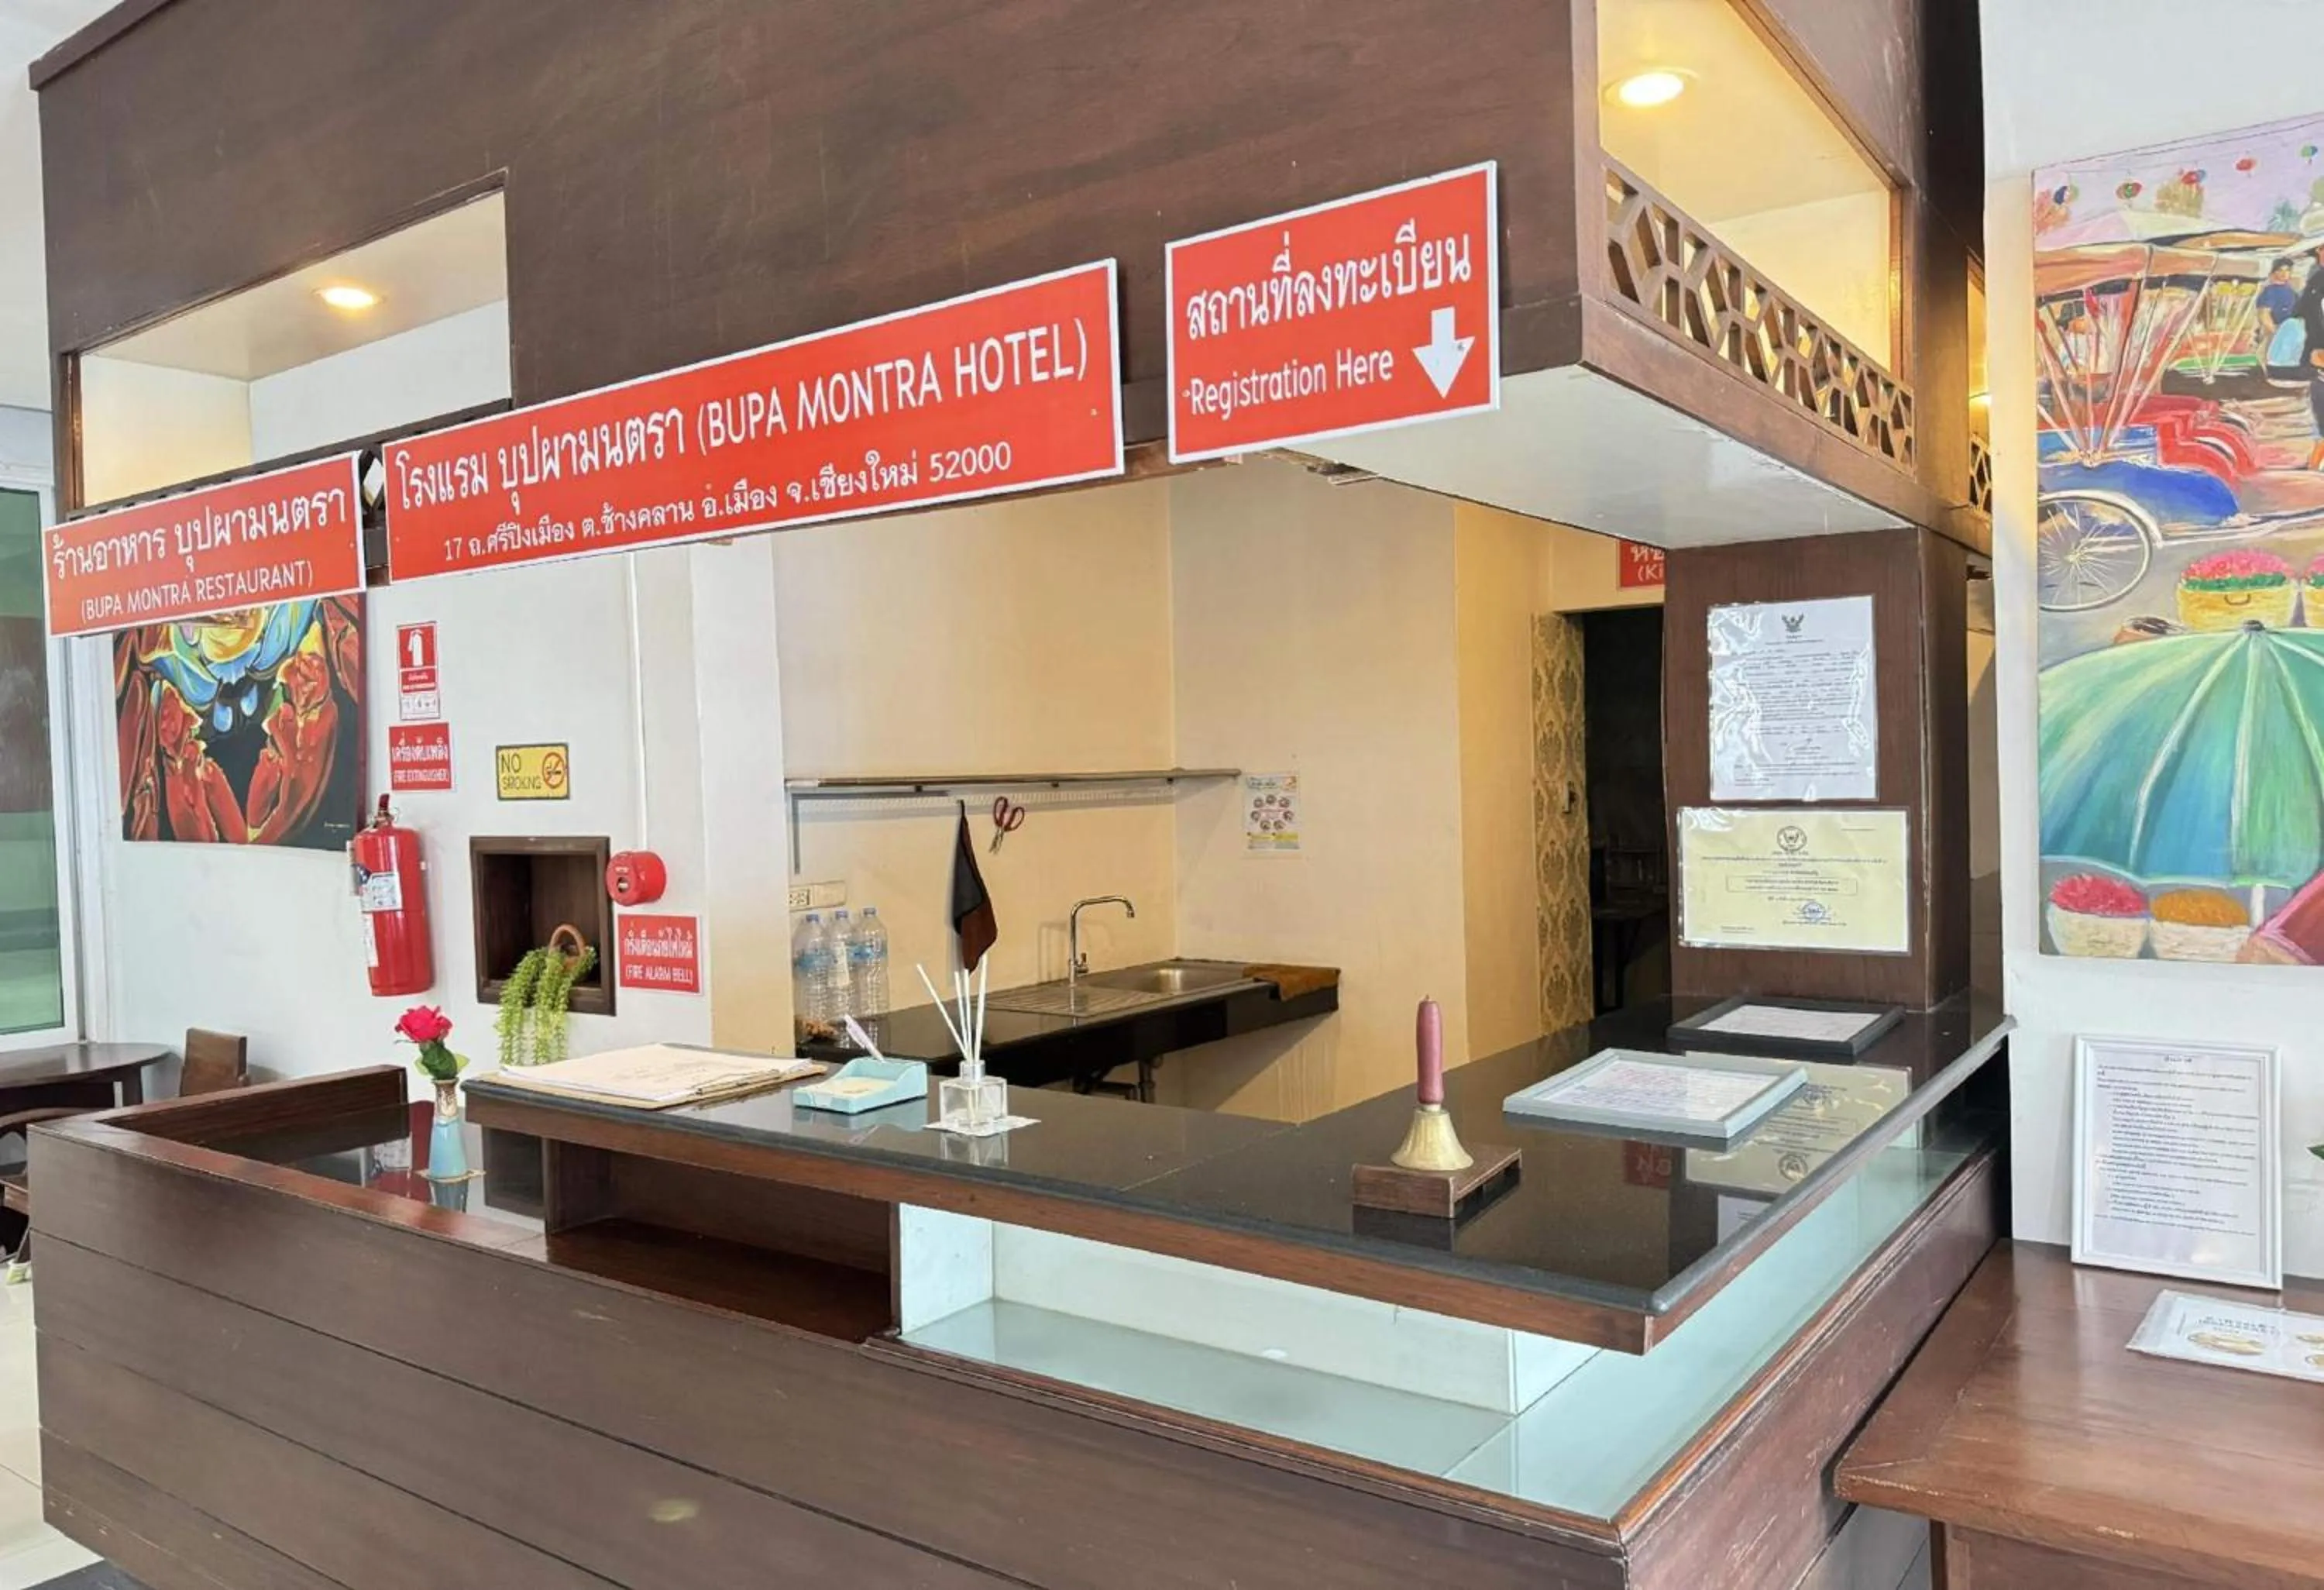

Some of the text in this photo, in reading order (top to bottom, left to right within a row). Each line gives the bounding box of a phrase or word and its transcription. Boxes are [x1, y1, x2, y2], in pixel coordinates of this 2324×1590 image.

[1186, 218, 1471, 340] สถานที่ลงทะเบียน
[395, 318, 1088, 515] โรงแรม บุปผามนตรา (BUPA MONTRA HOTEL)
[1190, 347, 1394, 421] Registration Here
[53, 487, 346, 580] ร้านอาหาร บุปผามนตรา
[444, 536, 462, 562] 17
[582, 500, 695, 538] ต.ช้างคลาน
[701, 477, 779, 518] อ.เมือง
[786, 449, 919, 504] จ.เชียงใหม่
[930, 440, 1012, 483] 52000
[81, 559, 313, 625] (BUPA MONTRA RESTAURANT)
[500, 753, 521, 773] NO
[501, 776, 542, 790] SMOKING
[645, 966, 671, 982] ALARM
